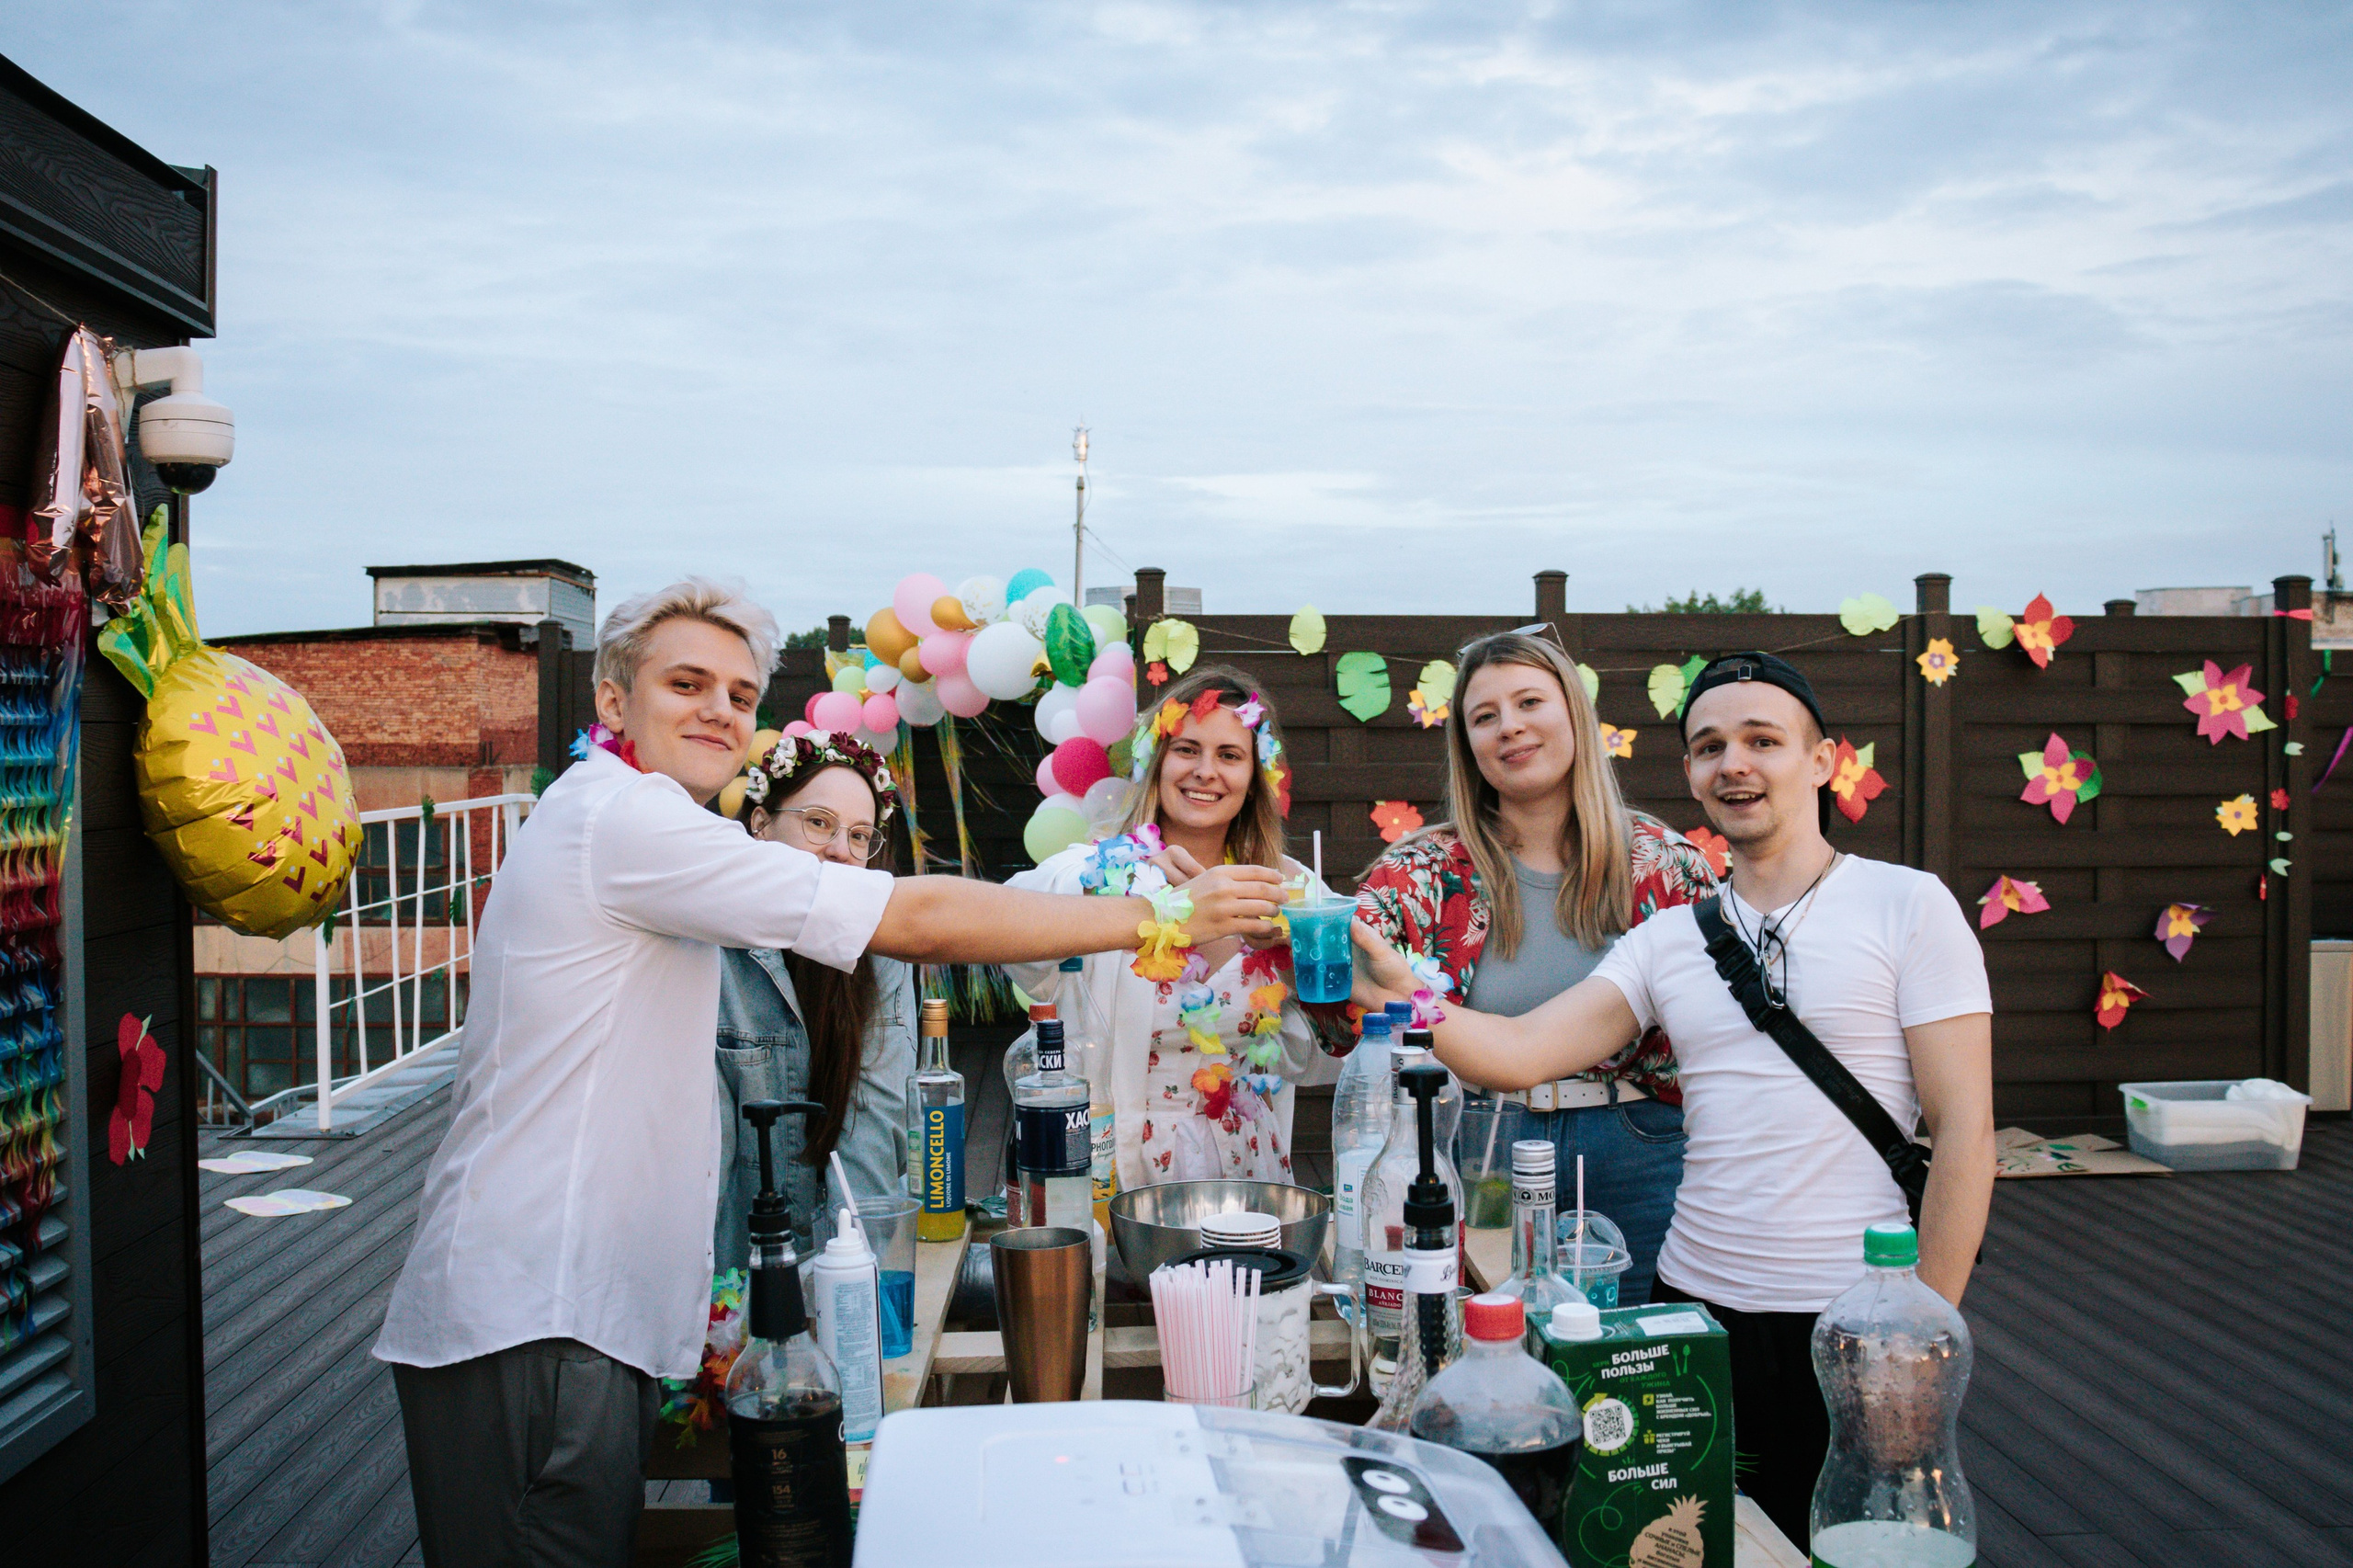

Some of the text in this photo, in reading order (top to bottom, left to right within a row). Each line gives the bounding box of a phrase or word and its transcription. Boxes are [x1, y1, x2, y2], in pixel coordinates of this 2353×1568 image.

[1037, 1054, 1062, 1069] СКИ
[1064, 1108, 1090, 1130] ХАС
[1091, 1138, 1116, 1153] РНОГО
[929, 1109, 945, 1209] LIMONCELLO
[1538, 1190, 1555, 1201] MO
[1369, 1288, 1404, 1301] BLANC
[1611, 1344, 1670, 1366] БОЛЬШЕ
[1601, 1361, 1654, 1379] ПОЛЬЗЫ
[1630, 1371, 1667, 1382] КАЖДОГО
[1641, 1380, 1671, 1389] УЖИНА
[771, 1449, 788, 1460] 16
[1608, 1462, 1669, 1483] БОЛЬШЕ
[772, 1484, 791, 1494] 154
[1651, 1478, 1677, 1490] СИЛ
[1644, 1531, 1670, 1546] СОЧНЫЕ
